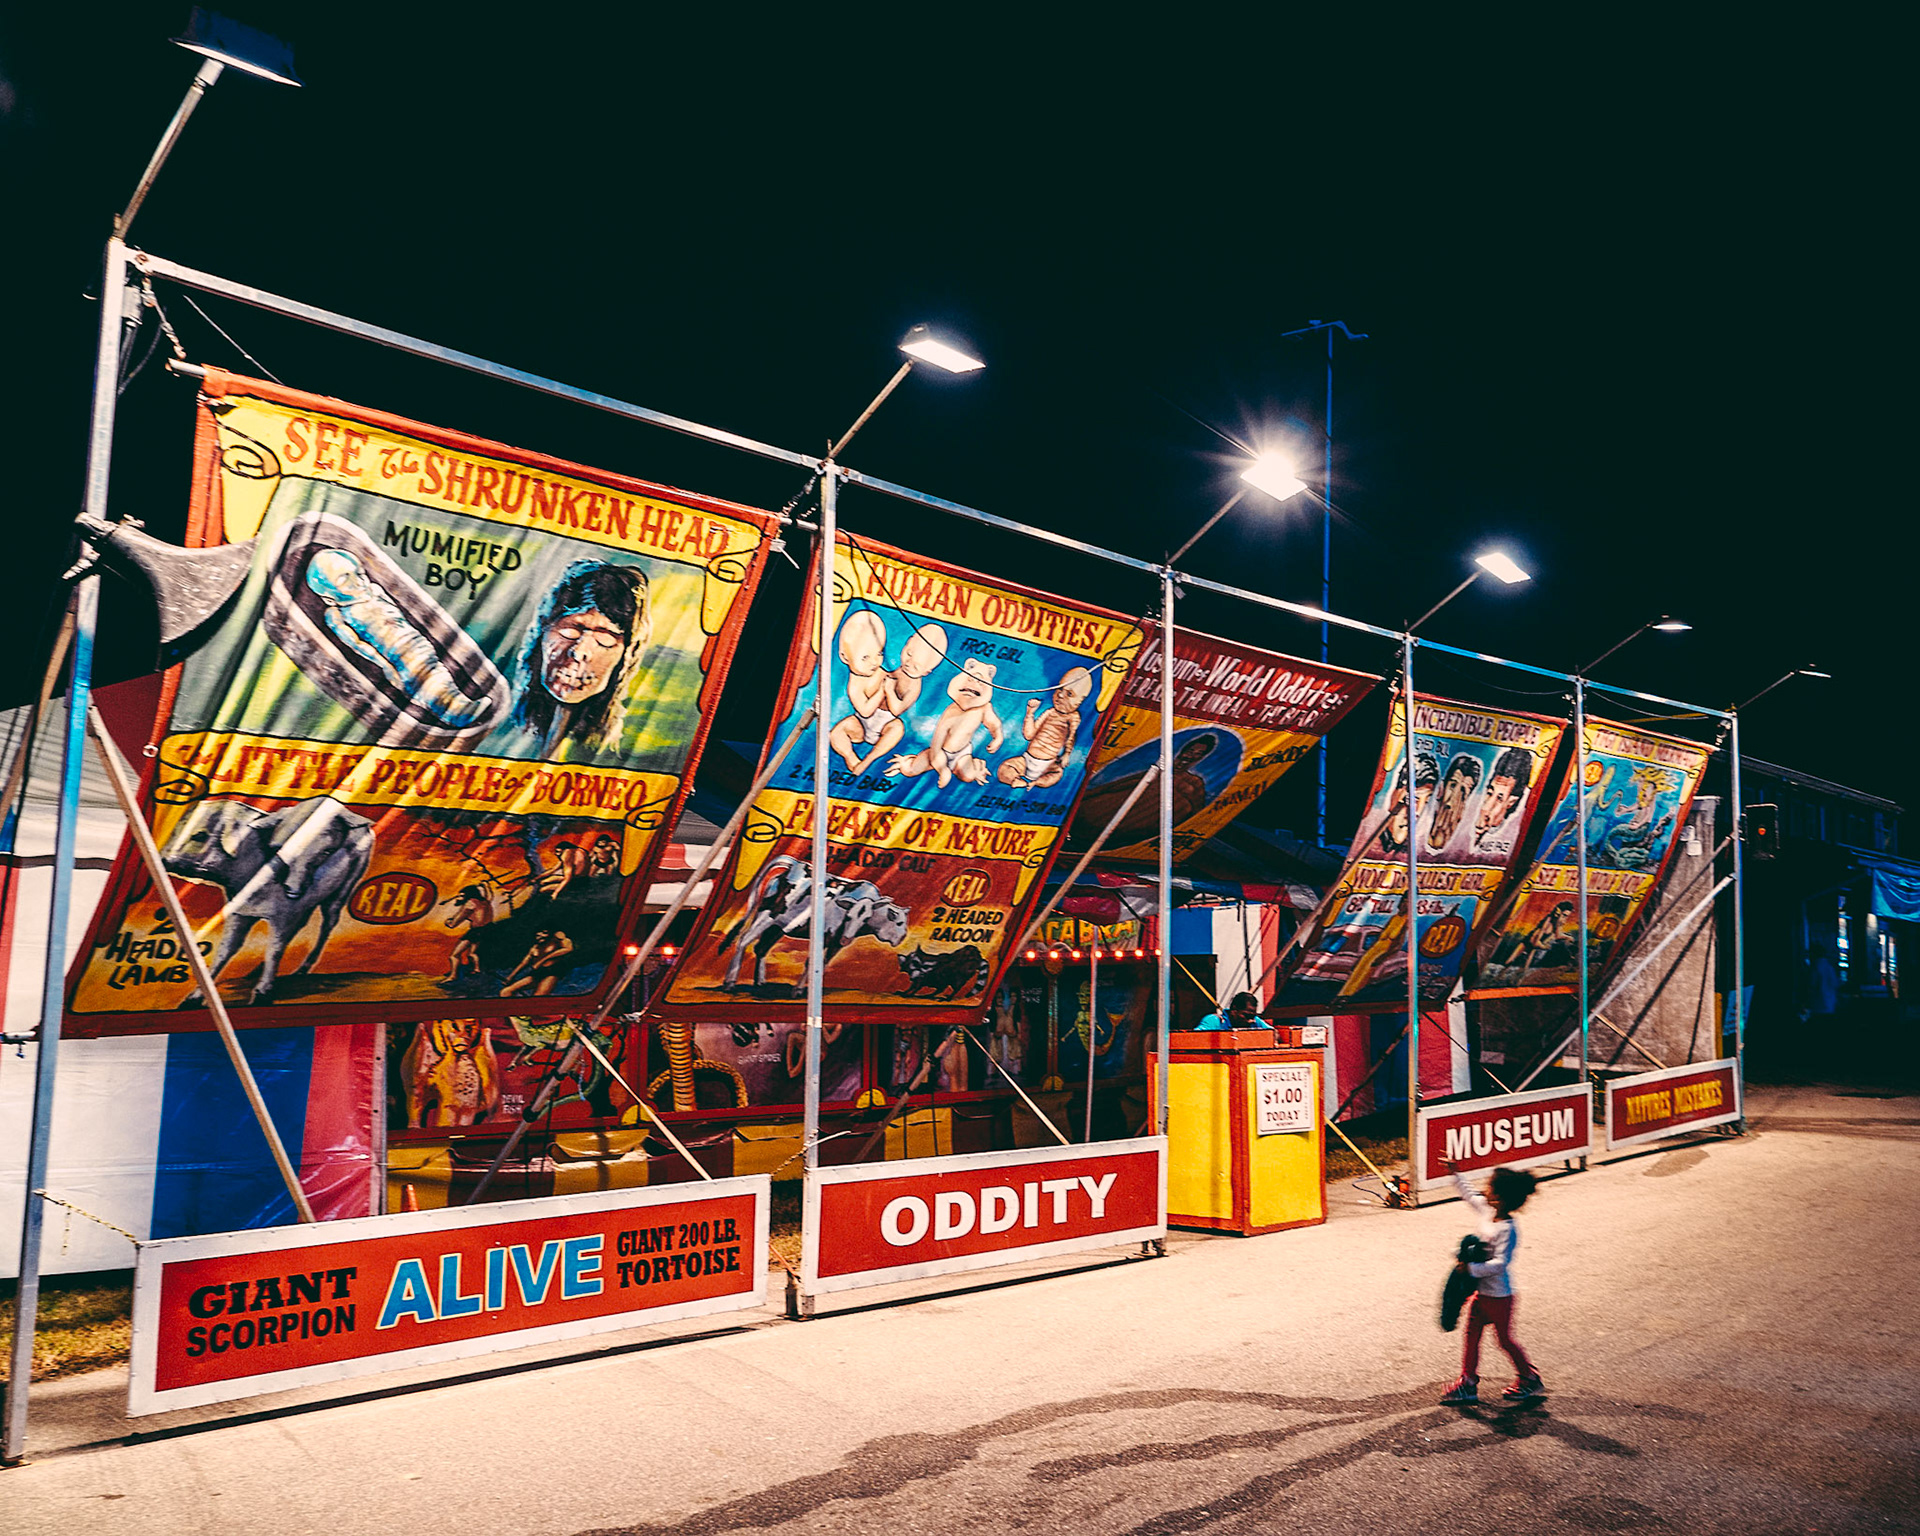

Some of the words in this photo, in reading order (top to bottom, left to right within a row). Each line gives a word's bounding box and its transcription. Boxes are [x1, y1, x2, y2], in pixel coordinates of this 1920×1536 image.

[284, 418, 369, 476] SEE
[418, 451, 635, 539] SHRUNKEN
[638, 505, 730, 559] HEAD
[384, 520, 522, 574] MUMIFIED
[424, 563, 487, 600] BOY
[866, 562, 972, 618] HUMAN
[981, 595, 1113, 654] ODDITIES!
[960, 637, 994, 658] FROG
[996, 644, 1025, 664] GIRL
[1204, 655, 1276, 697] World
[1413, 706, 1494, 738] INCREDIBLE
[211, 743, 364, 792] LITTLE
[365, 758, 509, 802] PEOPLE
[502, 771, 533, 802] of
[530, 770, 647, 812] BORNEO
[789, 765, 802, 778] 2
[856, 775, 898, 793] BABY
[904, 817, 943, 847] OF
[945, 822, 1037, 856] NATURE
[357, 882, 427, 918] REAL
[944, 874, 986, 903] REAL
[930, 927, 994, 943] RACOON
[931, 907, 947, 922] 2
[945, 909, 1004, 925] HEADED
[108, 965, 190, 990] LAMB
[1262, 1071, 1303, 1082] SPECIAL
[1264, 1088, 1303, 1105] $1.00
[1266, 1110, 1300, 1122] TODAY
[1445, 1108, 1575, 1160] MUSEUM
[880, 1172, 1118, 1247] ODDITY
[616, 1225, 678, 1258] GIANT
[679, 1221, 710, 1248] 200
[712, 1217, 741, 1244] LB.
[375, 1233, 605, 1330] ALIVE
[617, 1246, 741, 1289] TORTOISE
[188, 1266, 357, 1319] GIANT
[186, 1304, 356, 1358] SCORPION
